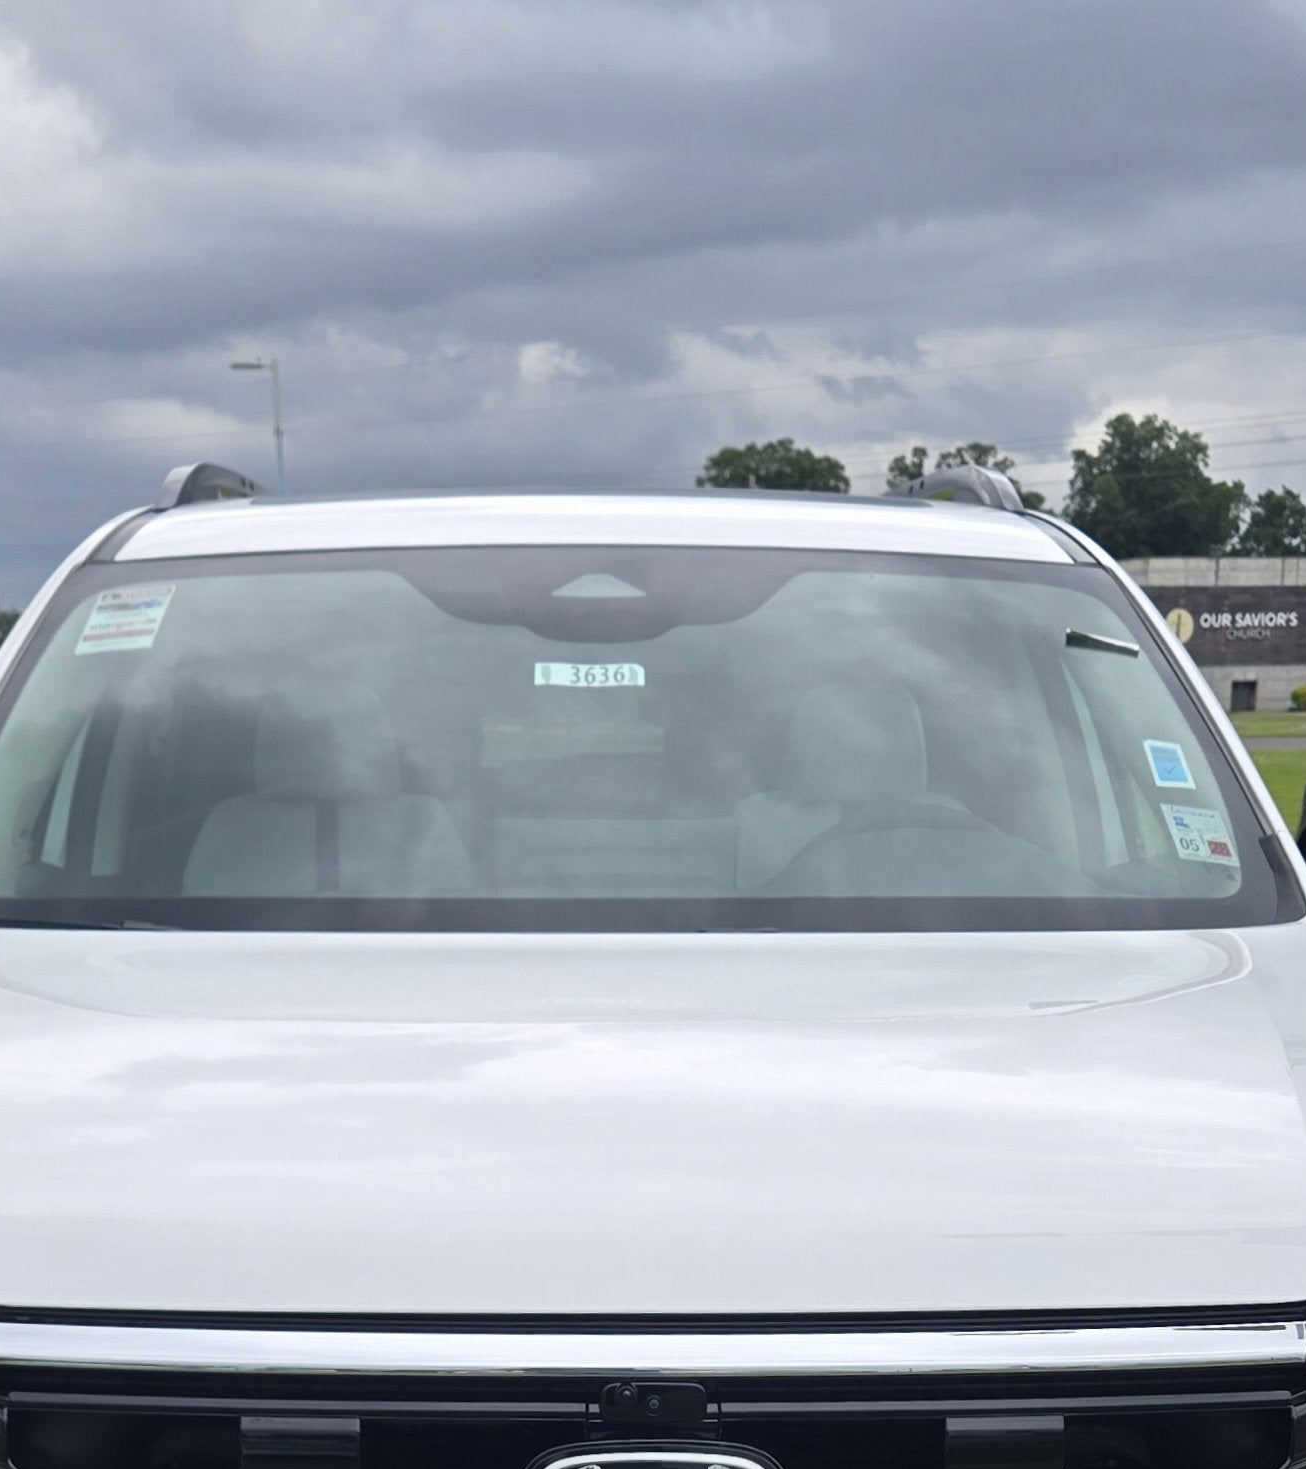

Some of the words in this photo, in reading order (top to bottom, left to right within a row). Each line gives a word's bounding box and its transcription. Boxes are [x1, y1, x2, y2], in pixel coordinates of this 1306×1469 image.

[1199, 611, 1233, 629] OUR
[1234, 611, 1299, 629] SAVIOR'S
[569, 665, 626, 685] 3636
[1179, 836, 1200, 852] 05
